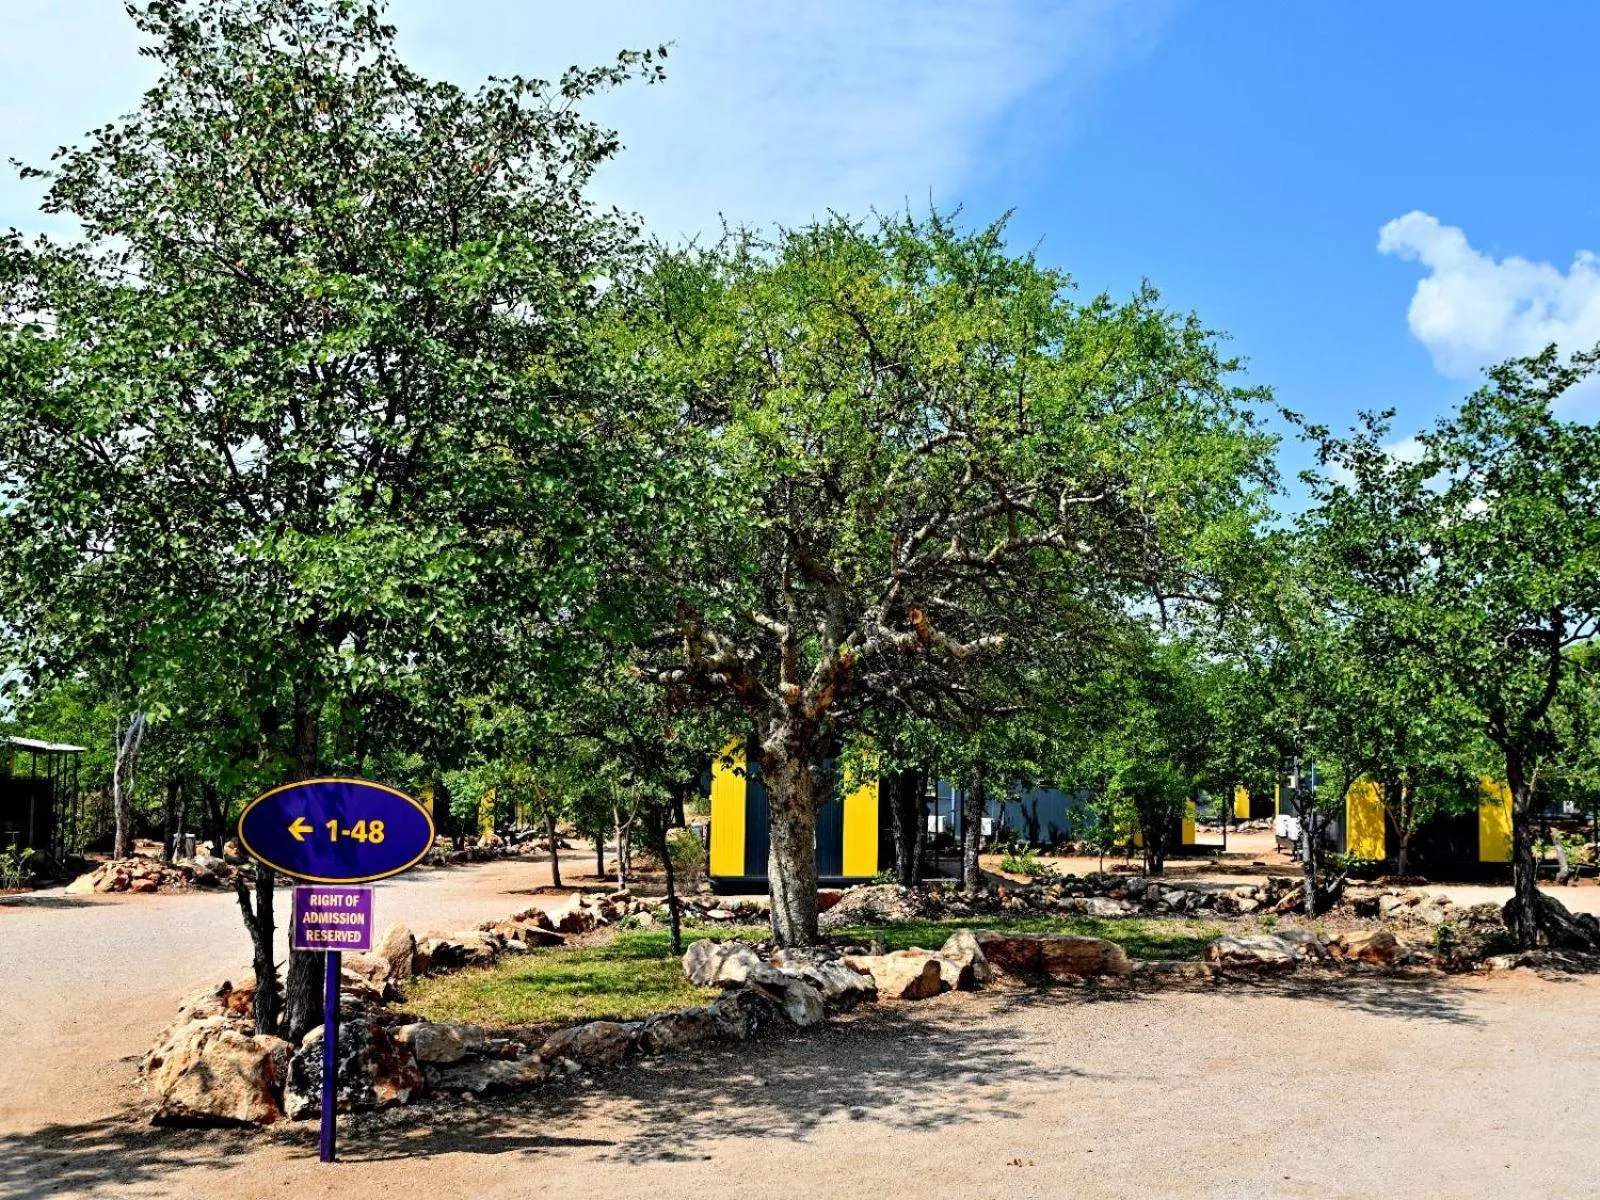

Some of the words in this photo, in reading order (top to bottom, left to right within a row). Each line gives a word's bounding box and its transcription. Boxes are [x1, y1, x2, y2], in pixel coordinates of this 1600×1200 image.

[326, 819, 385, 844] 1-48
[310, 894, 343, 907] RIGHT
[345, 894, 360, 907] OF
[303, 912, 365, 925] ADMISSION
[306, 930, 361, 943] RESERVED
